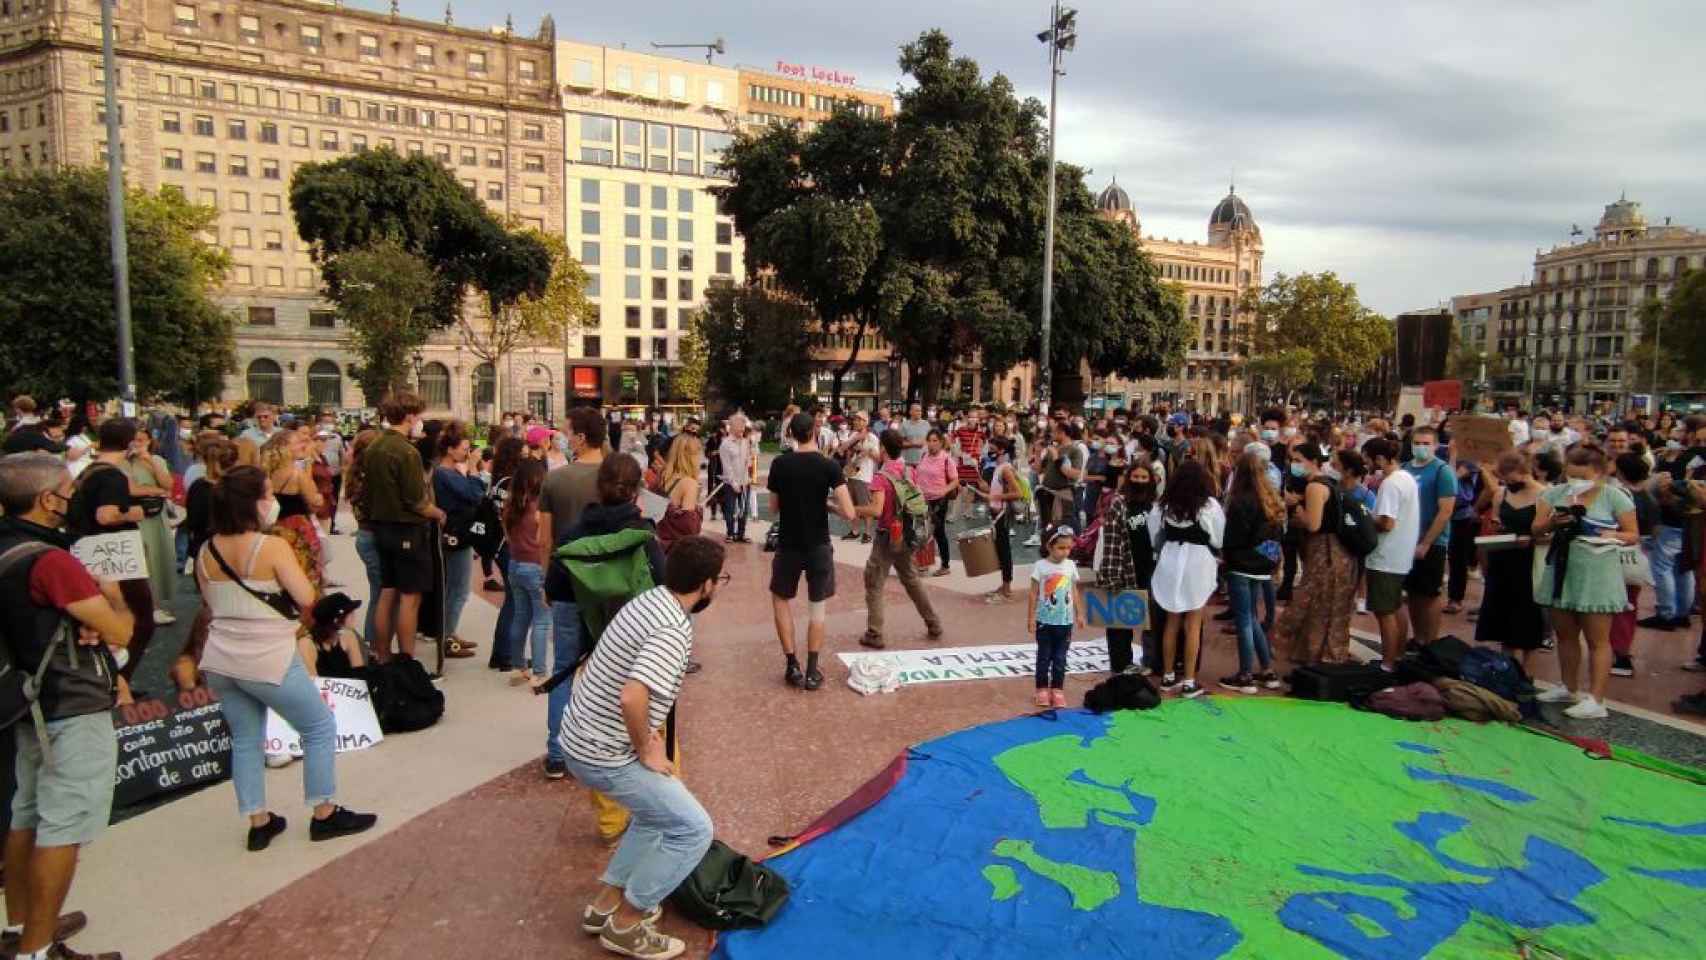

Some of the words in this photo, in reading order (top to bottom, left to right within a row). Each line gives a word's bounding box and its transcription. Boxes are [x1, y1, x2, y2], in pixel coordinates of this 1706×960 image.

[812, 66, 856, 85] Locker
[92, 540, 132, 557] ARE
[1085, 591, 1146, 625] NO
[322, 679, 369, 702] SISTEMA
[123, 735, 157, 752] cada
[169, 725, 194, 738] año
[203, 719, 222, 735] por
[337, 733, 372, 750] IMA
[159, 766, 181, 787] de
[191, 760, 221, 778] aire
